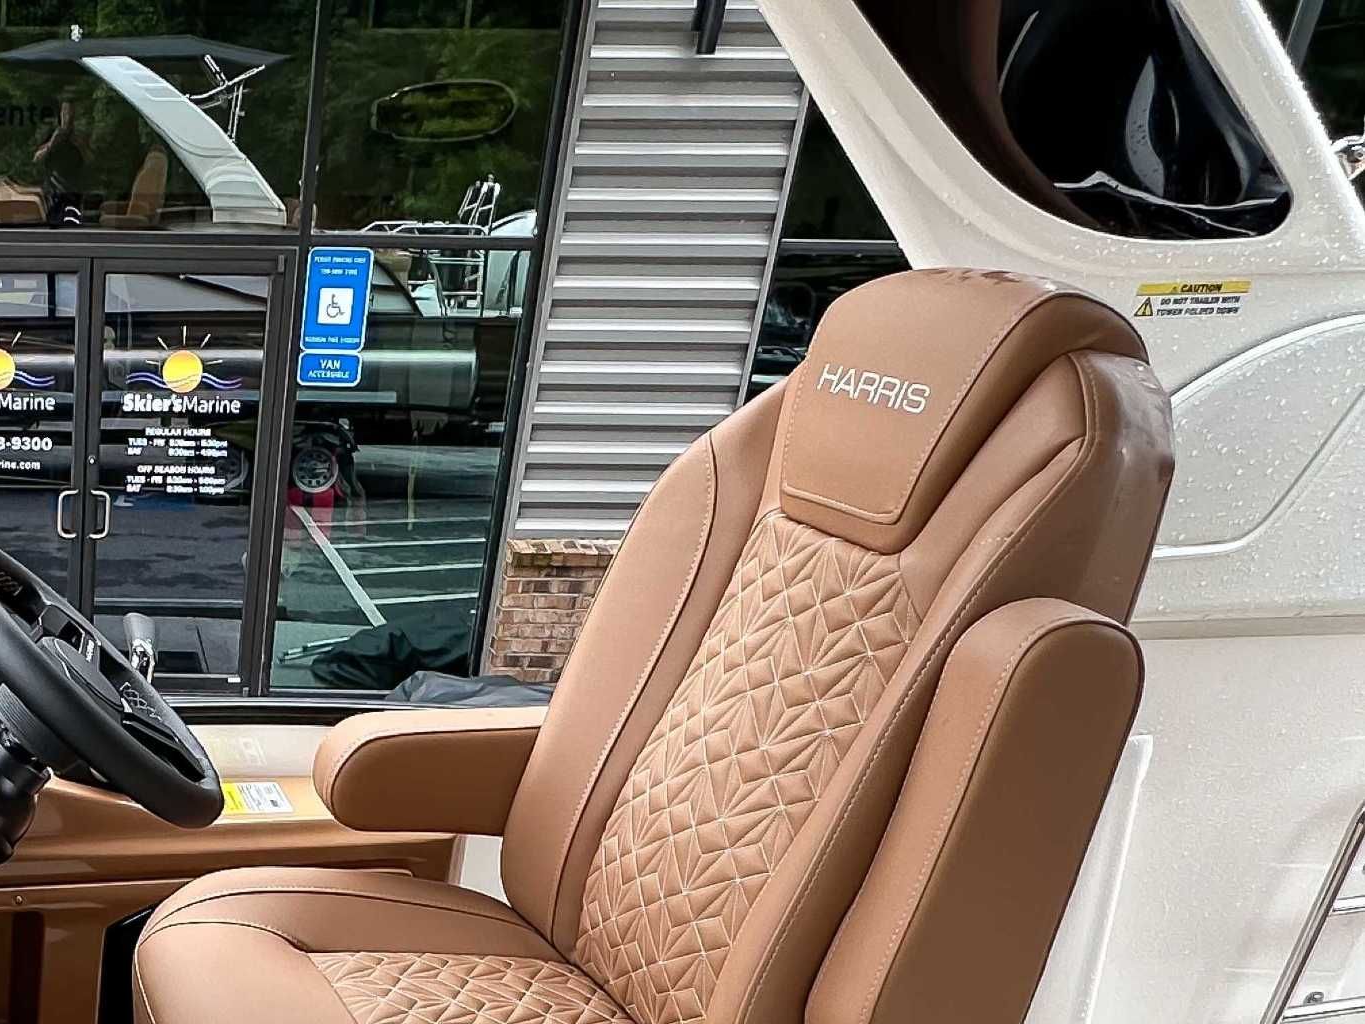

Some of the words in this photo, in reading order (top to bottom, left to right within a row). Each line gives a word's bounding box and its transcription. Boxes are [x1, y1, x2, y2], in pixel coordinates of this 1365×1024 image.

[1180, 283, 1223, 293] CAUTION
[1172, 297, 1188, 305] NOT
[320, 359, 341, 370] VAN
[816, 362, 932, 414] HARRIS
